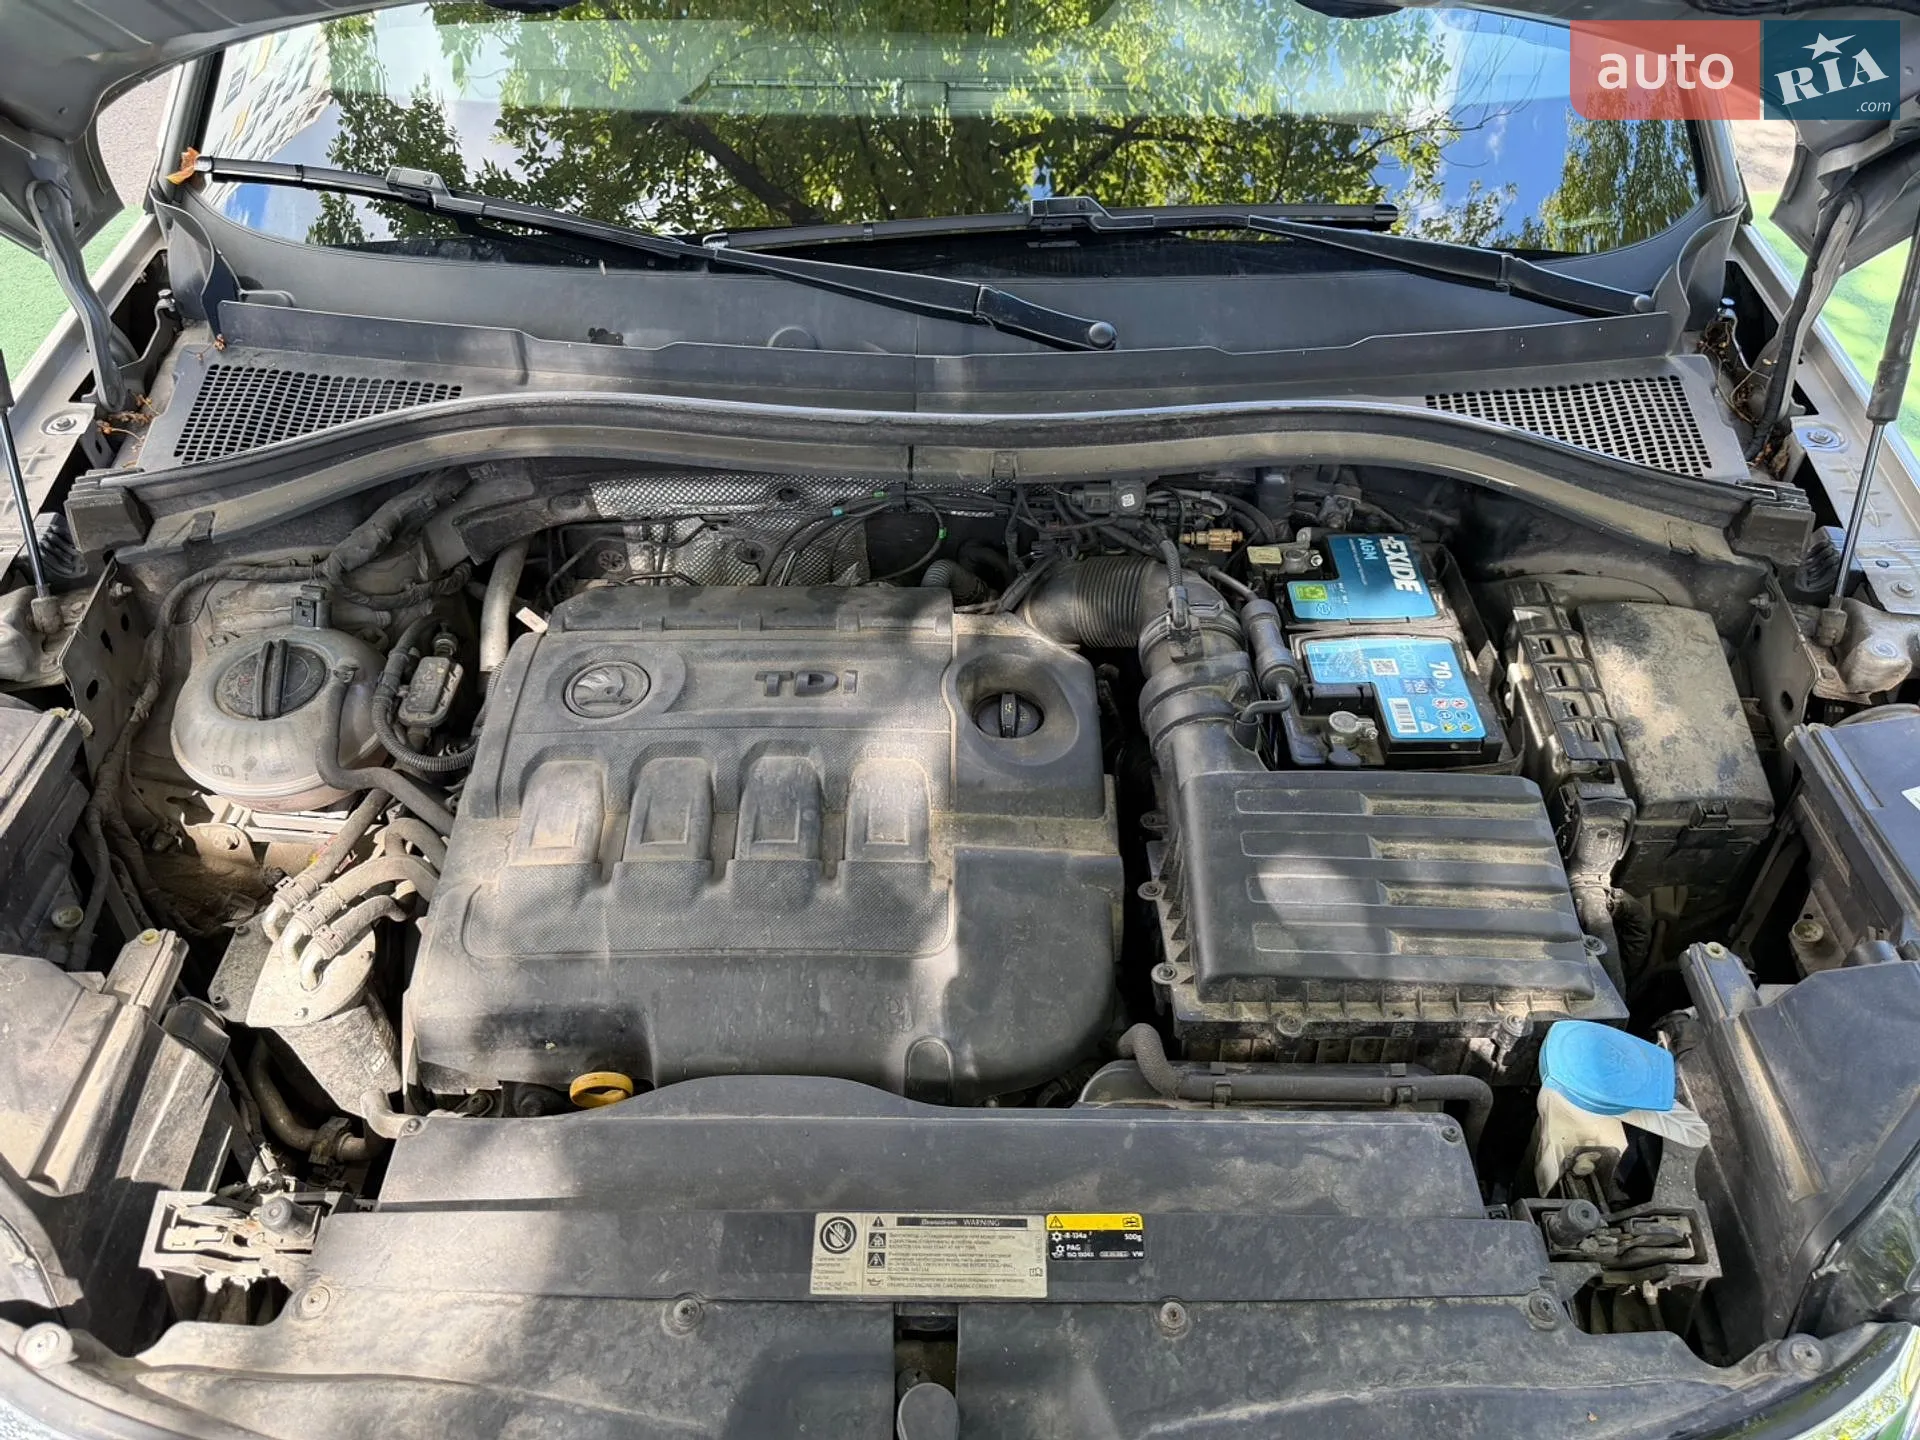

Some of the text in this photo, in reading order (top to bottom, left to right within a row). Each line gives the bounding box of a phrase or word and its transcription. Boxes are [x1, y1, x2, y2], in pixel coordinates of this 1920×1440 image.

[1358, 538, 1379, 560] AGM
[1379, 536, 1424, 594] EXIDE
[1429, 661, 1453, 680] 70
[754, 669, 859, 697] TDI
[963, 1218, 1000, 1227] WARNING
